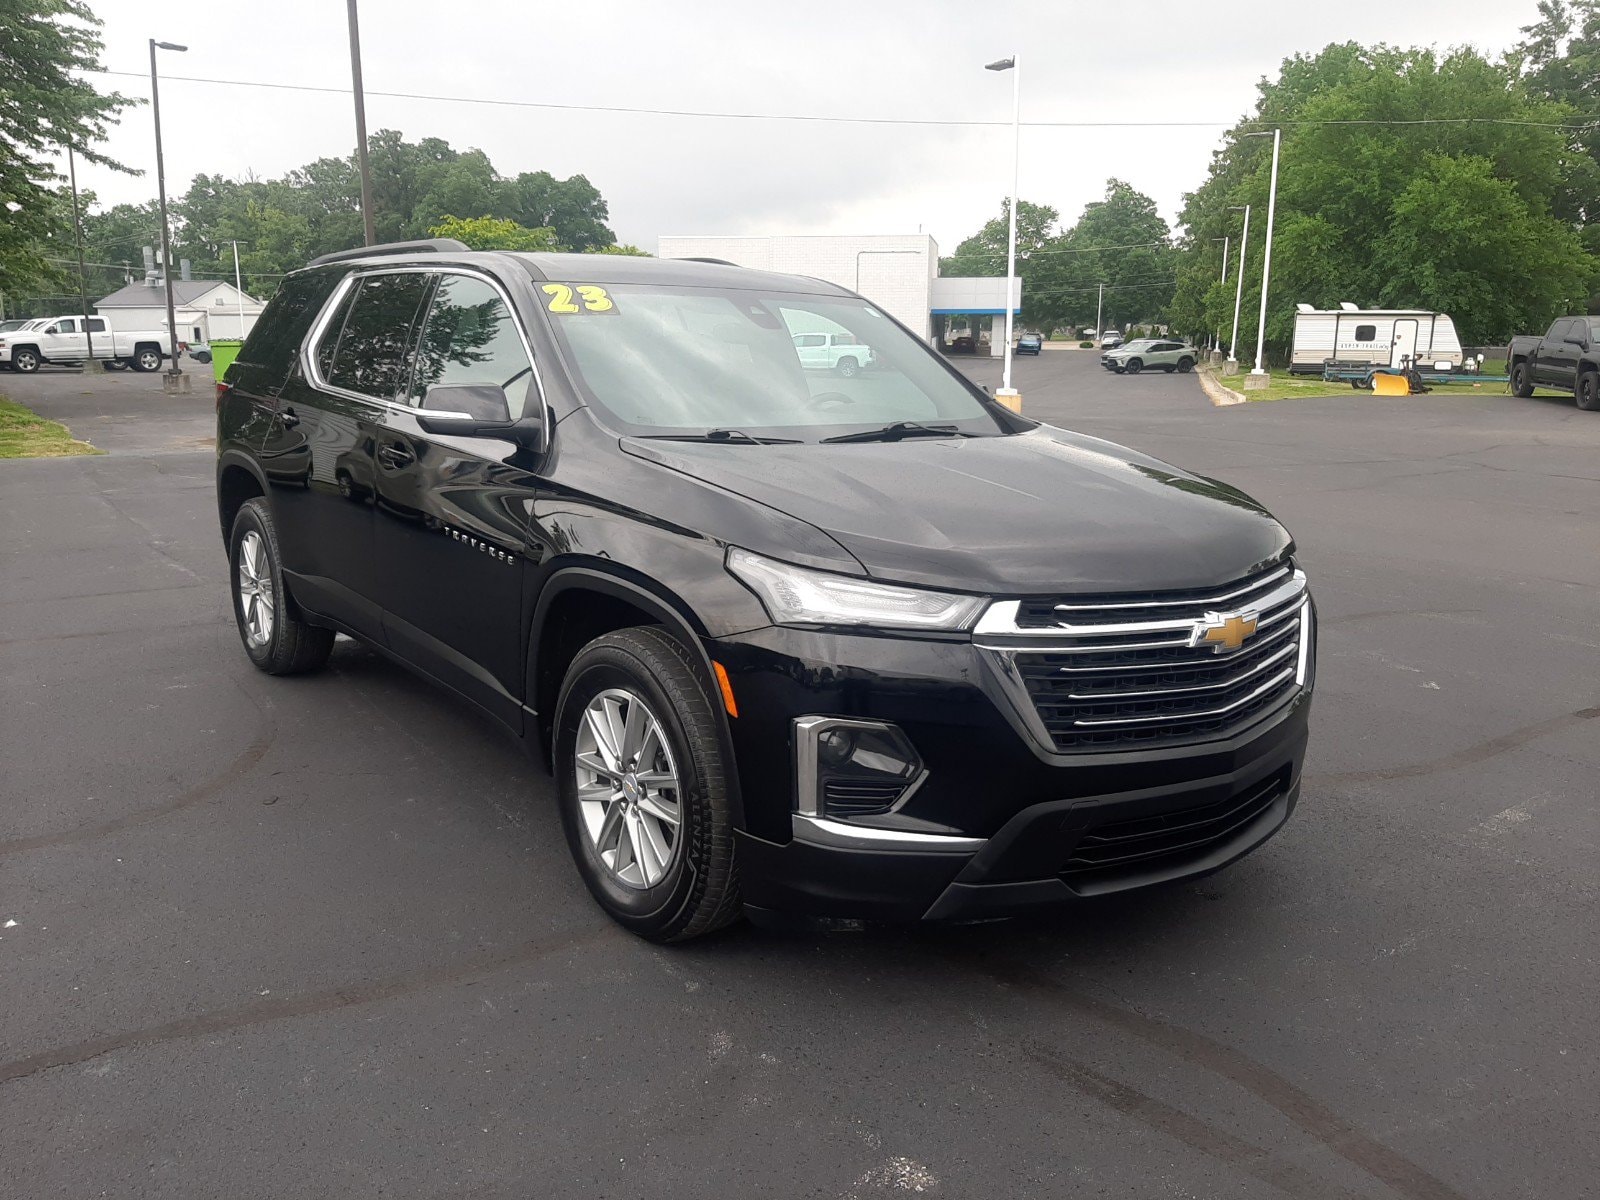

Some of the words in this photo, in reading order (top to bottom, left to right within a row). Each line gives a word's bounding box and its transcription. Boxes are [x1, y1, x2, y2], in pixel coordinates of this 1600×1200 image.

[541, 284, 613, 313] 23
[444, 526, 514, 566] TRAVERSE
[691, 792, 701, 858] ALENZA
